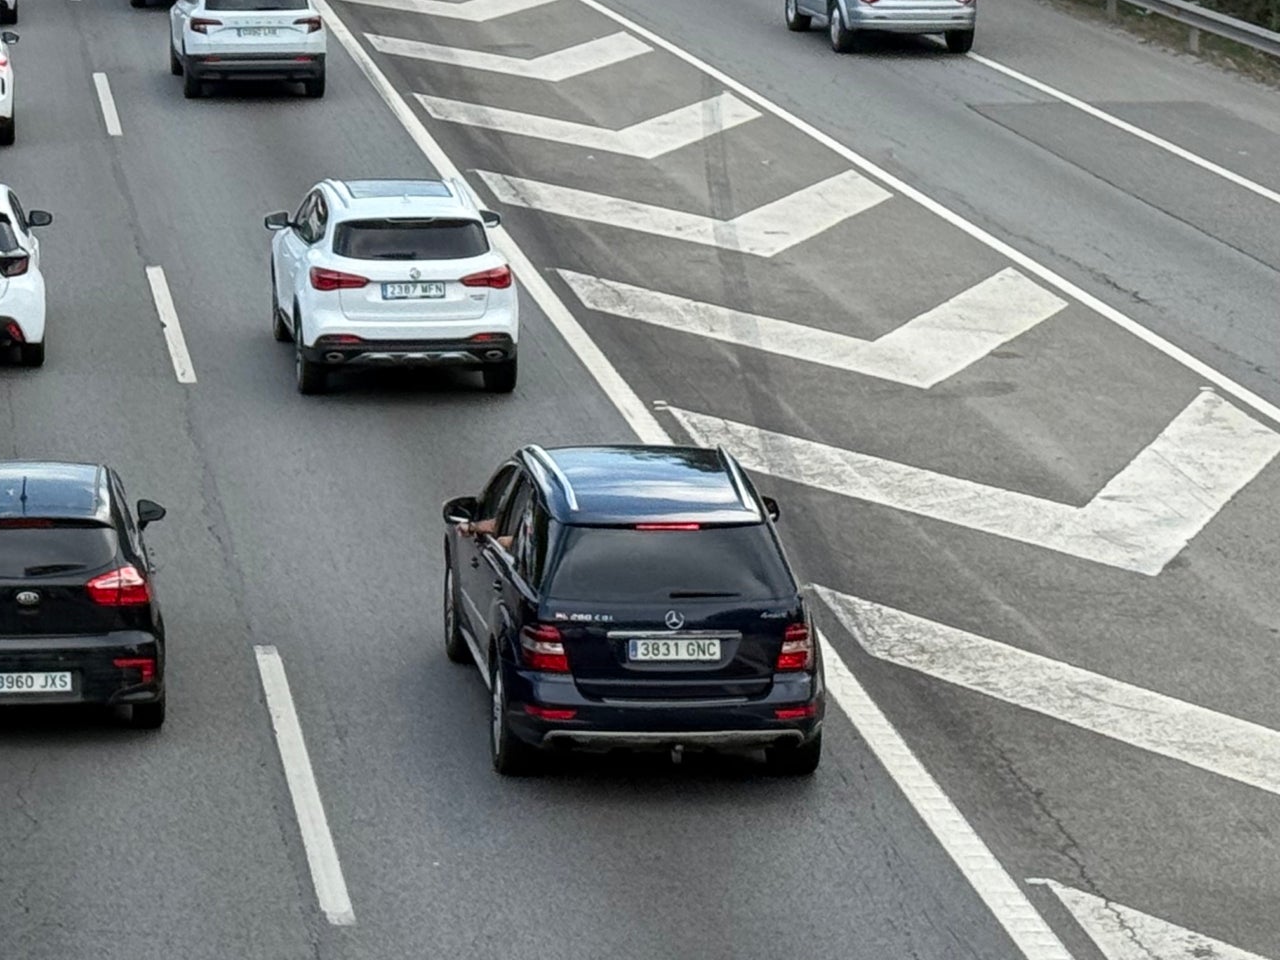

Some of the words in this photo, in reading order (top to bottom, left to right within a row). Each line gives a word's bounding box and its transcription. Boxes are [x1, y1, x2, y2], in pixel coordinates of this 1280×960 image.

[640, 642, 680, 657] 3831
[686, 641, 717, 657] GNC
[39, 673, 68, 689] JXS
